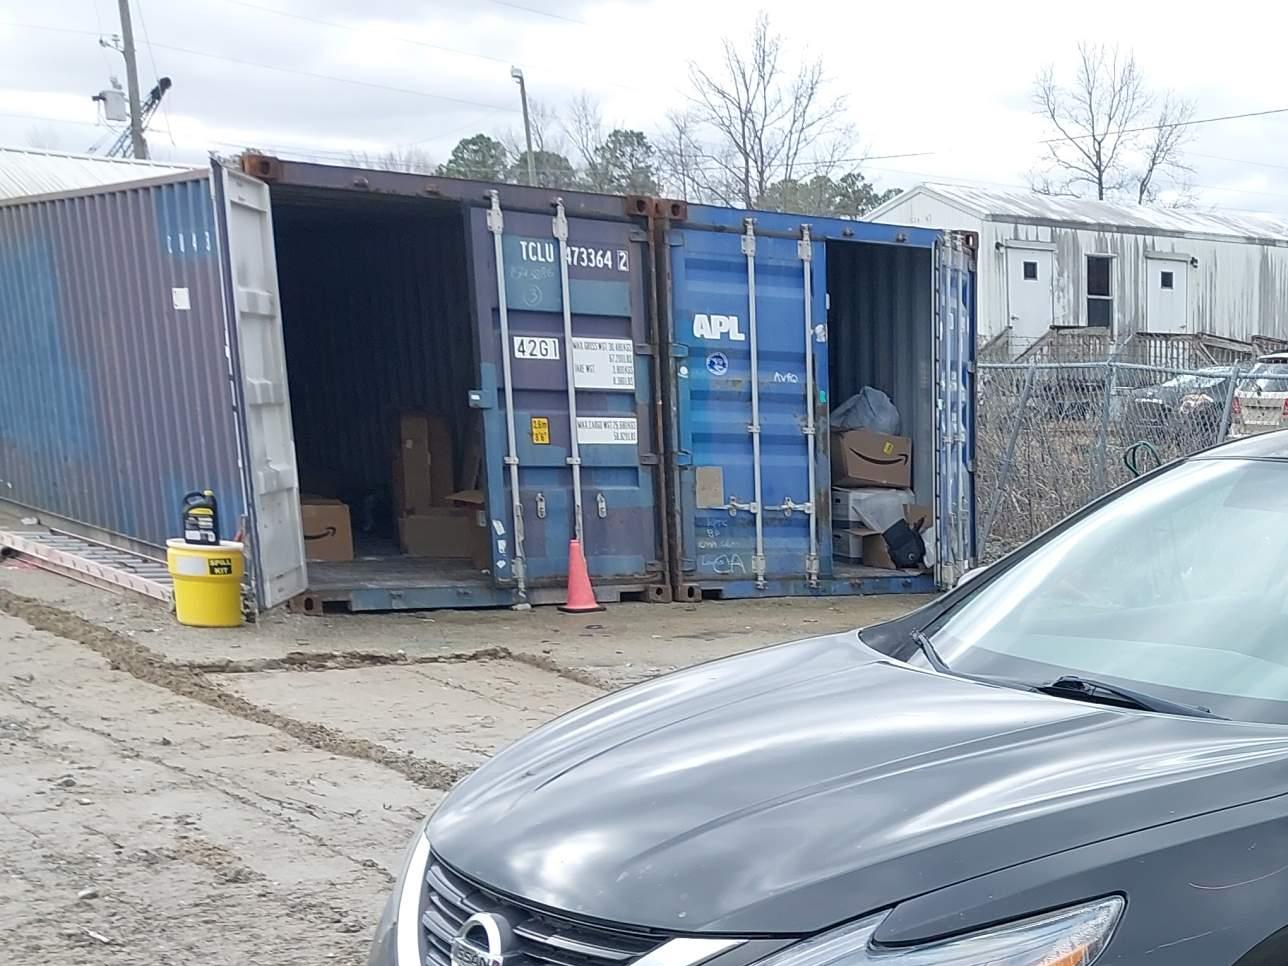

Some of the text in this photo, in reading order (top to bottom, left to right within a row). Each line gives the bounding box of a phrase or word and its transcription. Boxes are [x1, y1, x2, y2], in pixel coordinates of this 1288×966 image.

[520, 241, 629, 271] TCLU 473364 2
[693, 314, 745, 340] APL
[517, 339, 558, 357] 42G1
